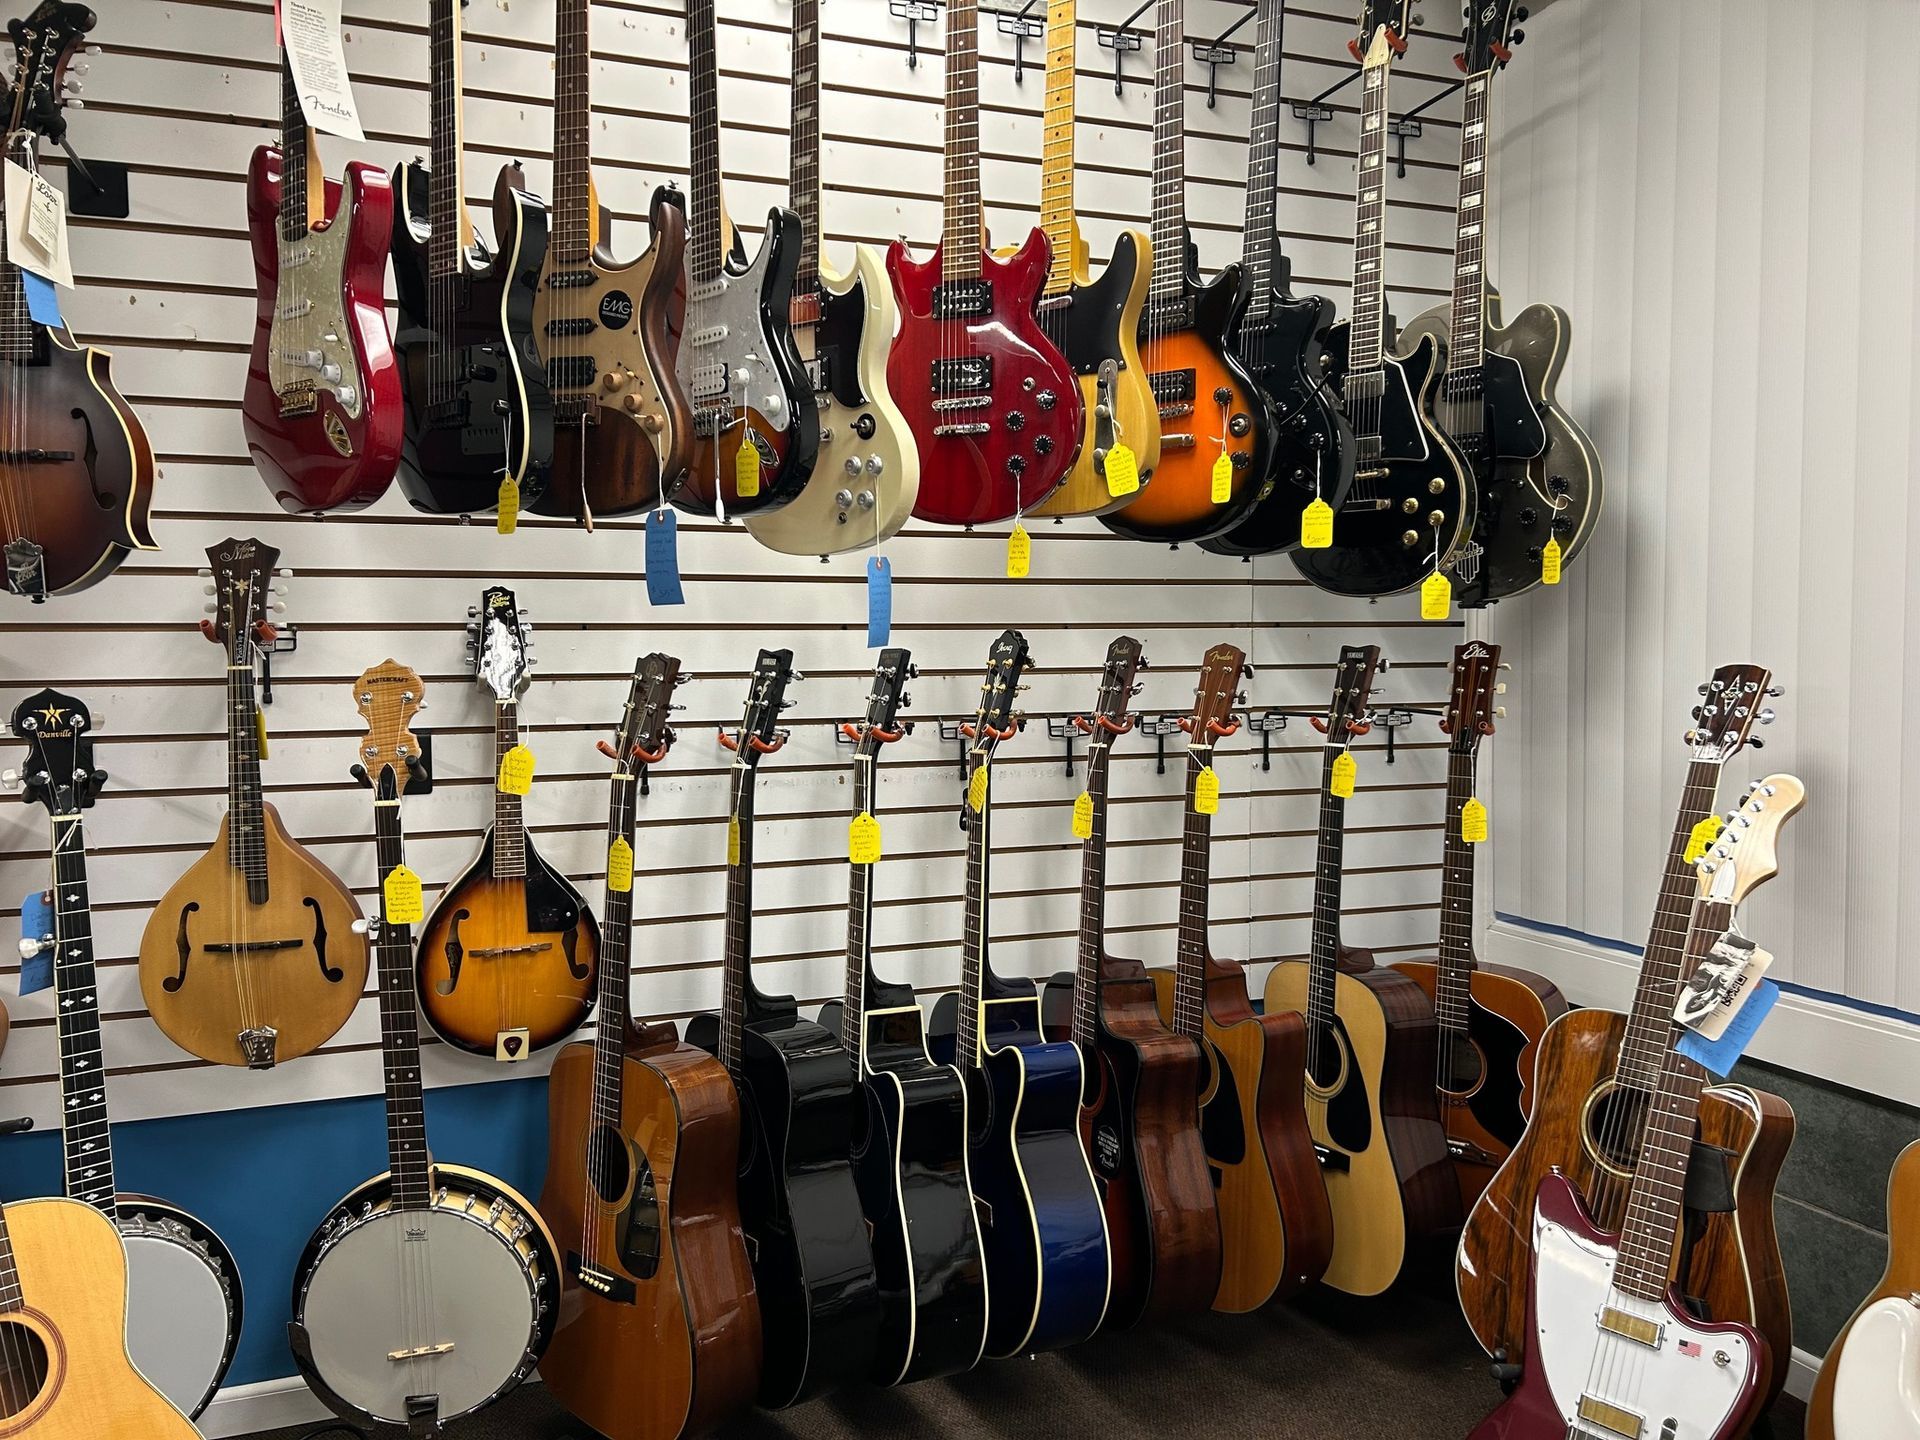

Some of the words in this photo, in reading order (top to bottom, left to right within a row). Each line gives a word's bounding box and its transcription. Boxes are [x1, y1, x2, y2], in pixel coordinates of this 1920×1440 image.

[305, 95, 352, 117] Fender
[603, 298, 630, 314] EMG
[1209, 650, 1233, 662] Fender
[366, 676, 409, 685] MASTERCRAFT
[38, 729, 72, 738] Danville
